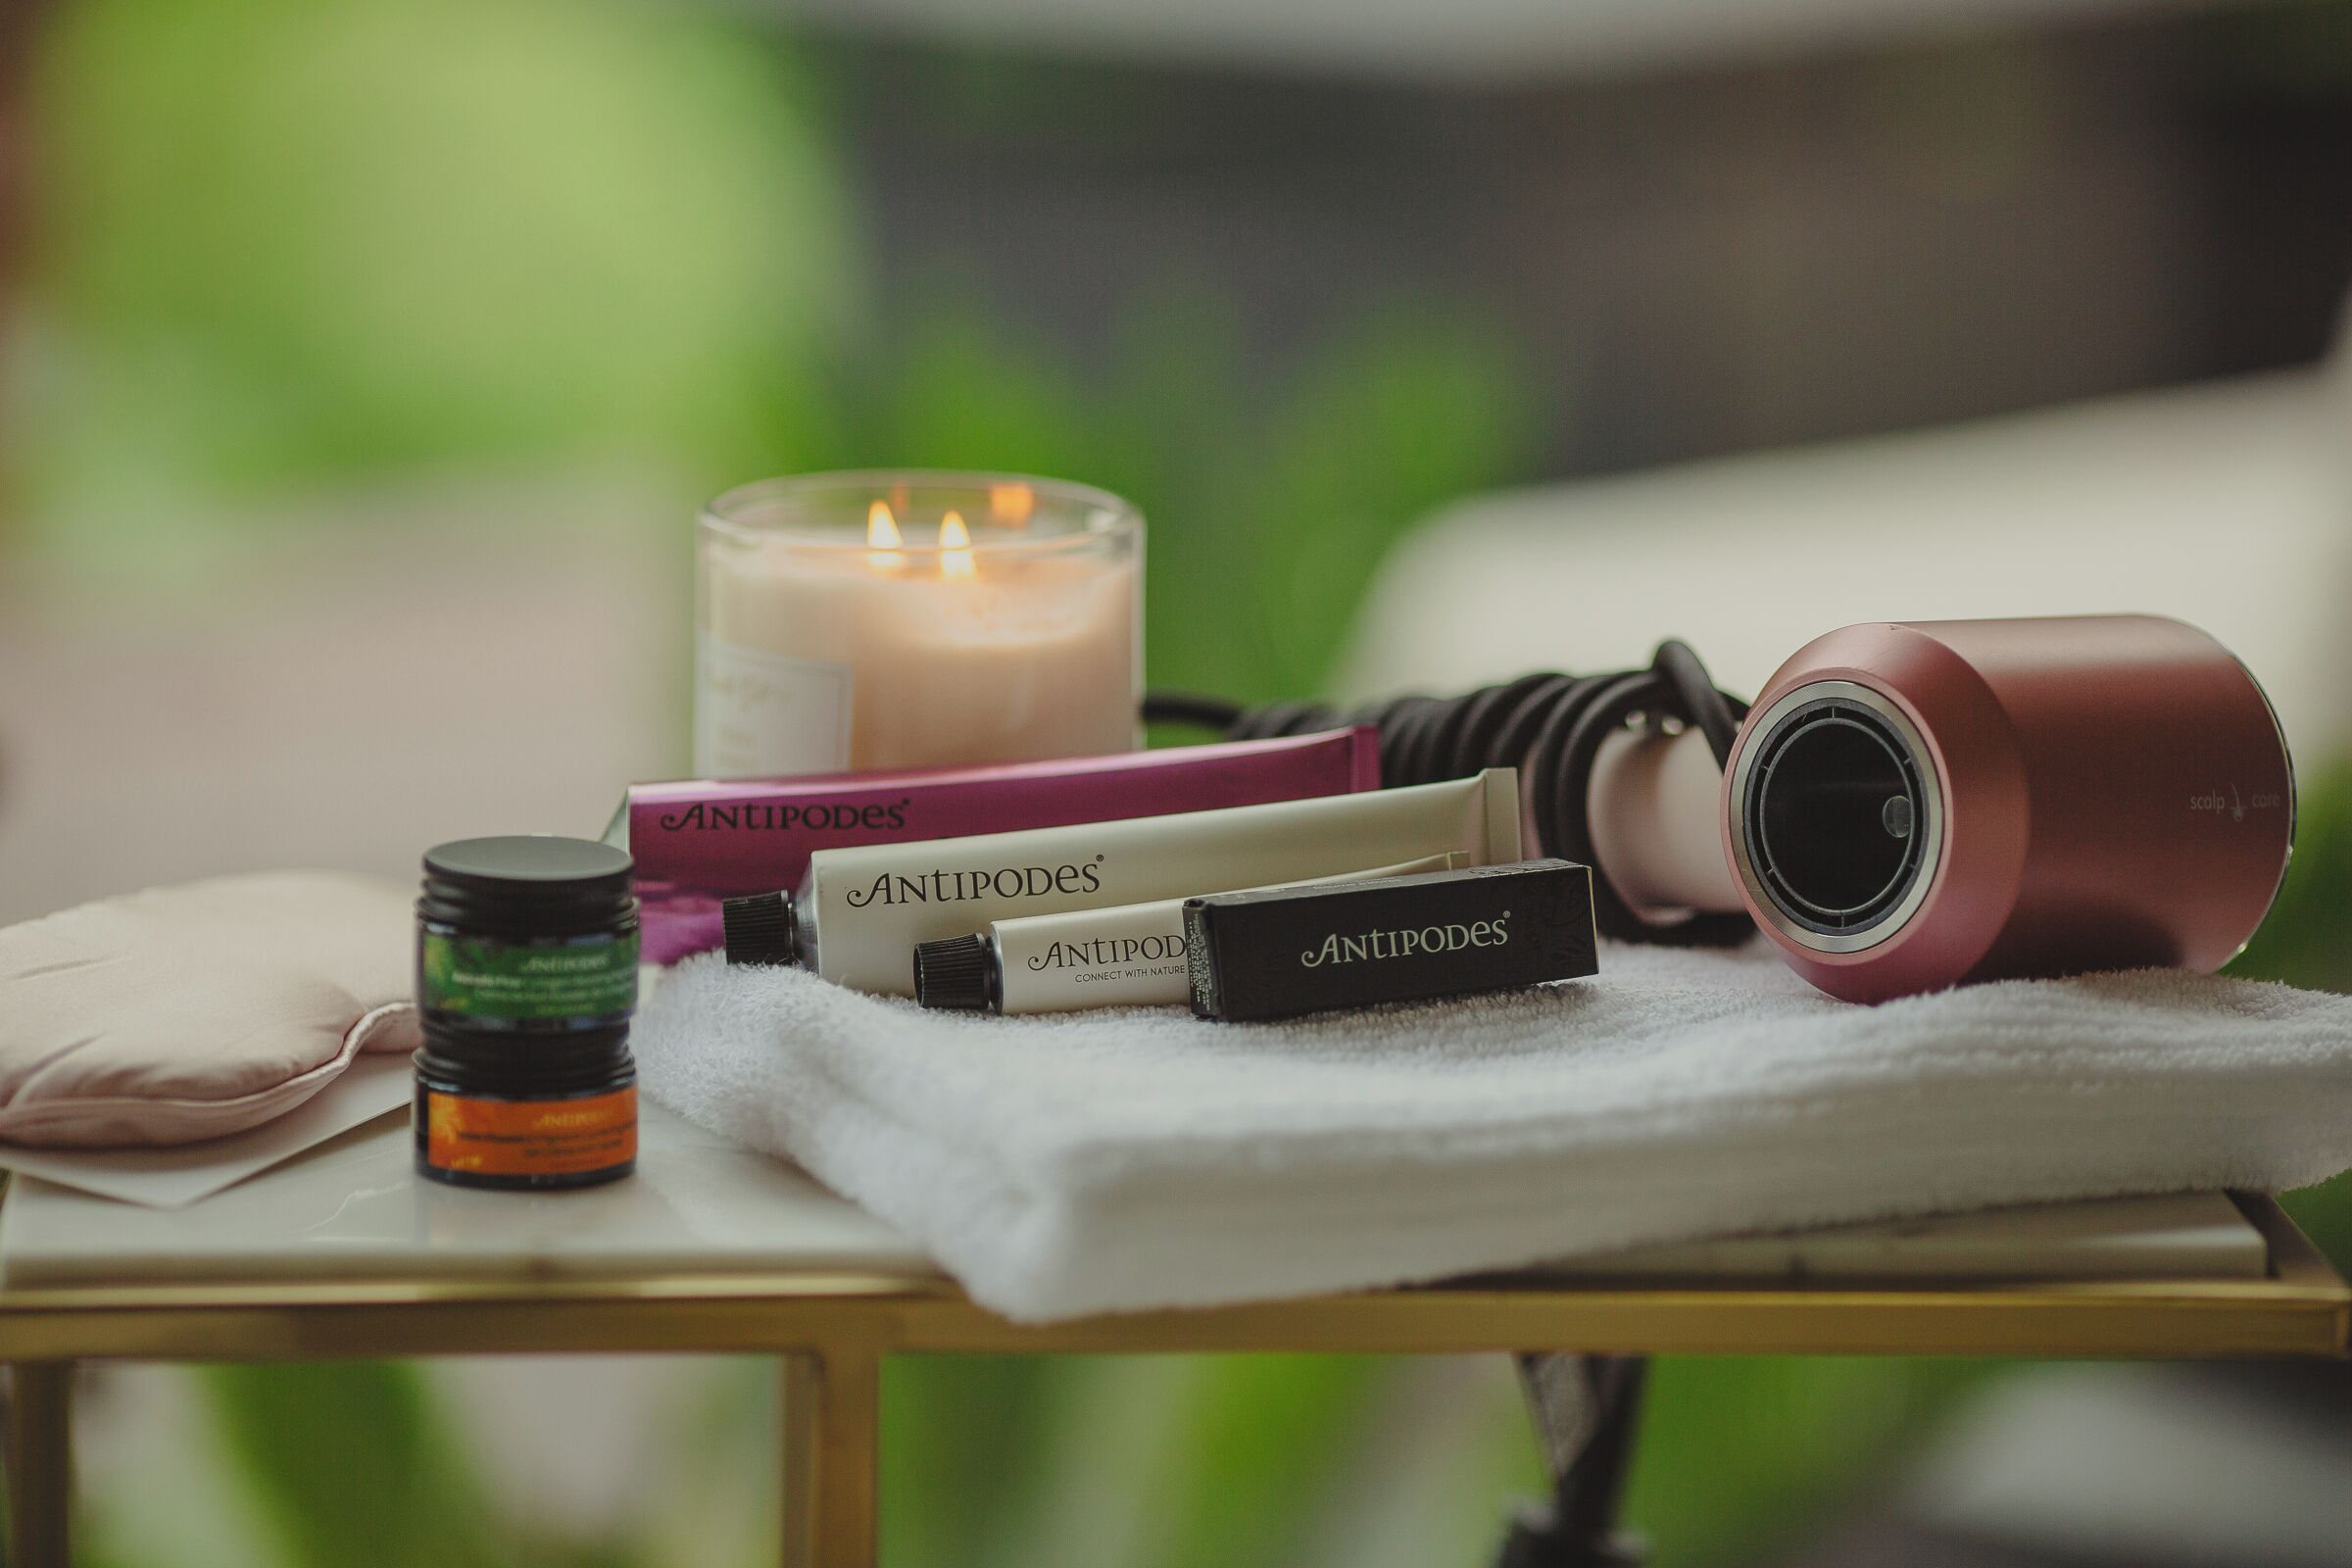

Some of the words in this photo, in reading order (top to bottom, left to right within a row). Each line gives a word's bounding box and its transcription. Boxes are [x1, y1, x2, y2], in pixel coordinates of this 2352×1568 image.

[2189, 788, 2226, 814] scalp
[2251, 793, 2281, 808] care
[1074, 970, 1122, 983] CONNECT
[1124, 967, 1148, 979] WITH
[1150, 964, 1186, 977] NATURE
